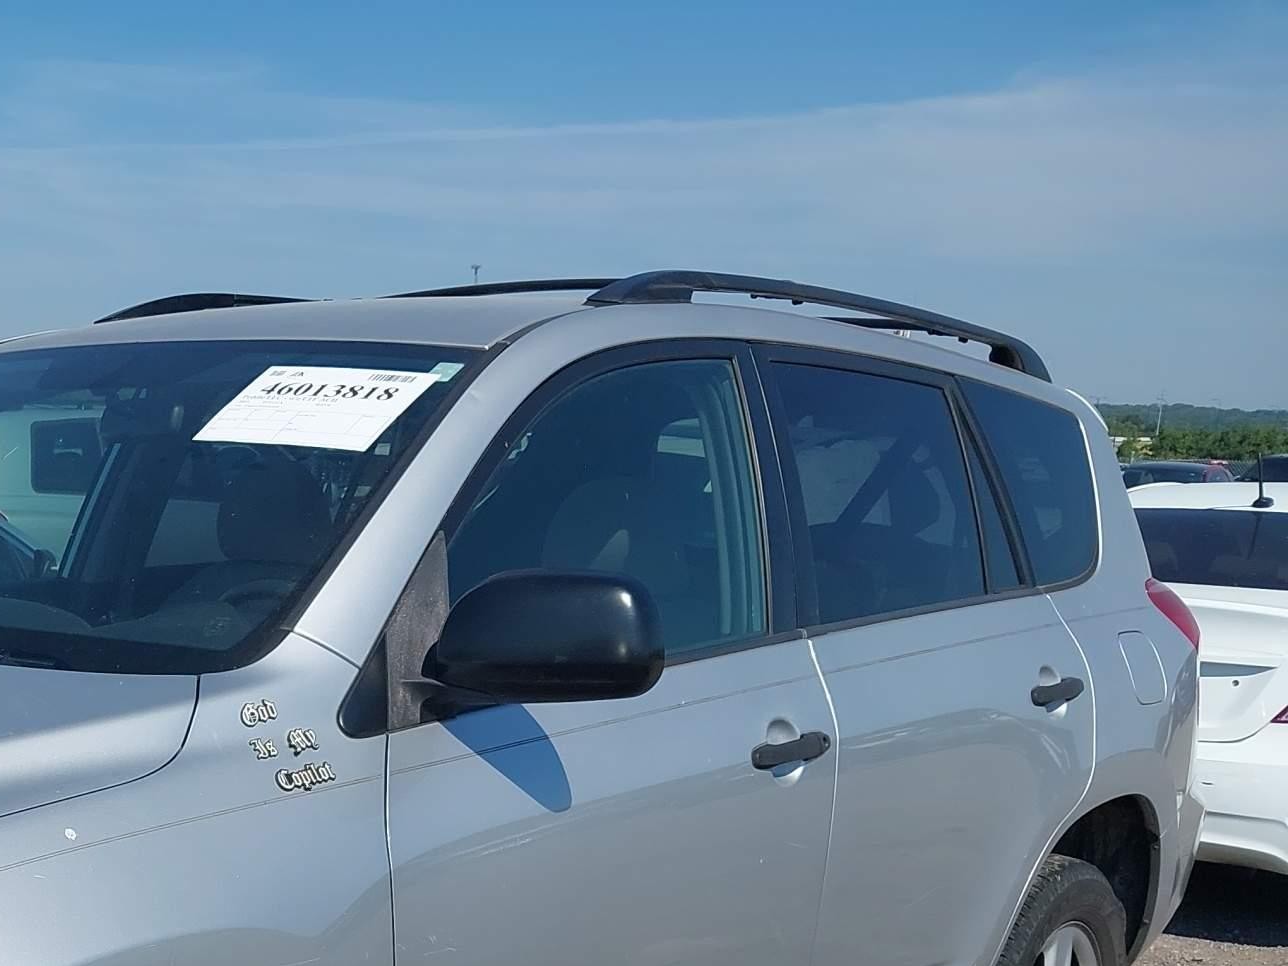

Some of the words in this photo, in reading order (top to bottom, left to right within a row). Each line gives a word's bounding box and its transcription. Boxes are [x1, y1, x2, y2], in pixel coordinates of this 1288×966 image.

[260, 382, 400, 401] 46013818
[241, 699, 277, 727] God
[287, 728, 320, 757] My
[275, 761, 336, 792] Copilot
